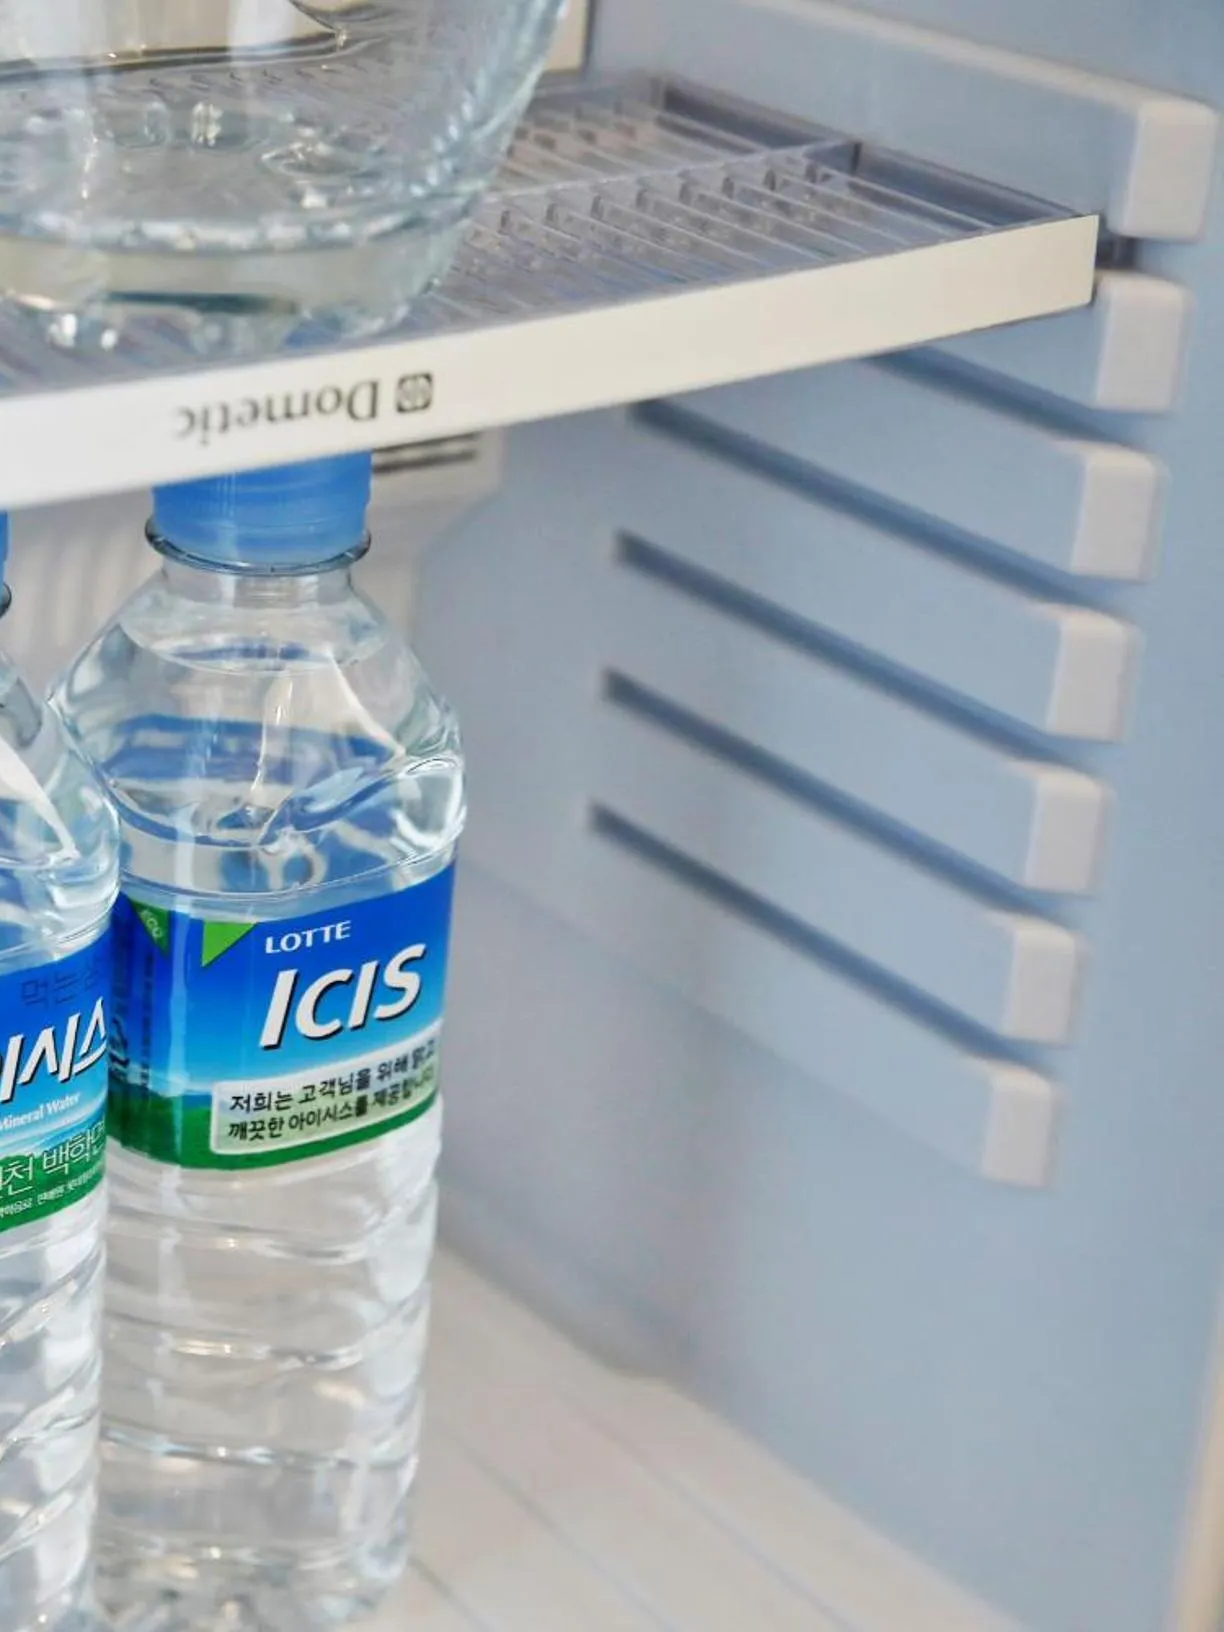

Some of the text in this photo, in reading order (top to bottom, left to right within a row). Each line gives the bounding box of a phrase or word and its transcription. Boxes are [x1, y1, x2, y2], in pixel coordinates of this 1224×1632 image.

[176, 379, 379, 446] Dometic
[264, 920, 352, 954] LOTTE
[259, 943, 427, 1051] ICIS
[46, 1092, 81, 1115] Water
[229, 1091, 293, 1114] 저희는
[298, 1067, 371, 1105] 고객님을
[376, 1054, 409, 1082] 위해
[228, 1116, 285, 1141] 깨끗한
[288, 1094, 368, 1132] 아이시스를
